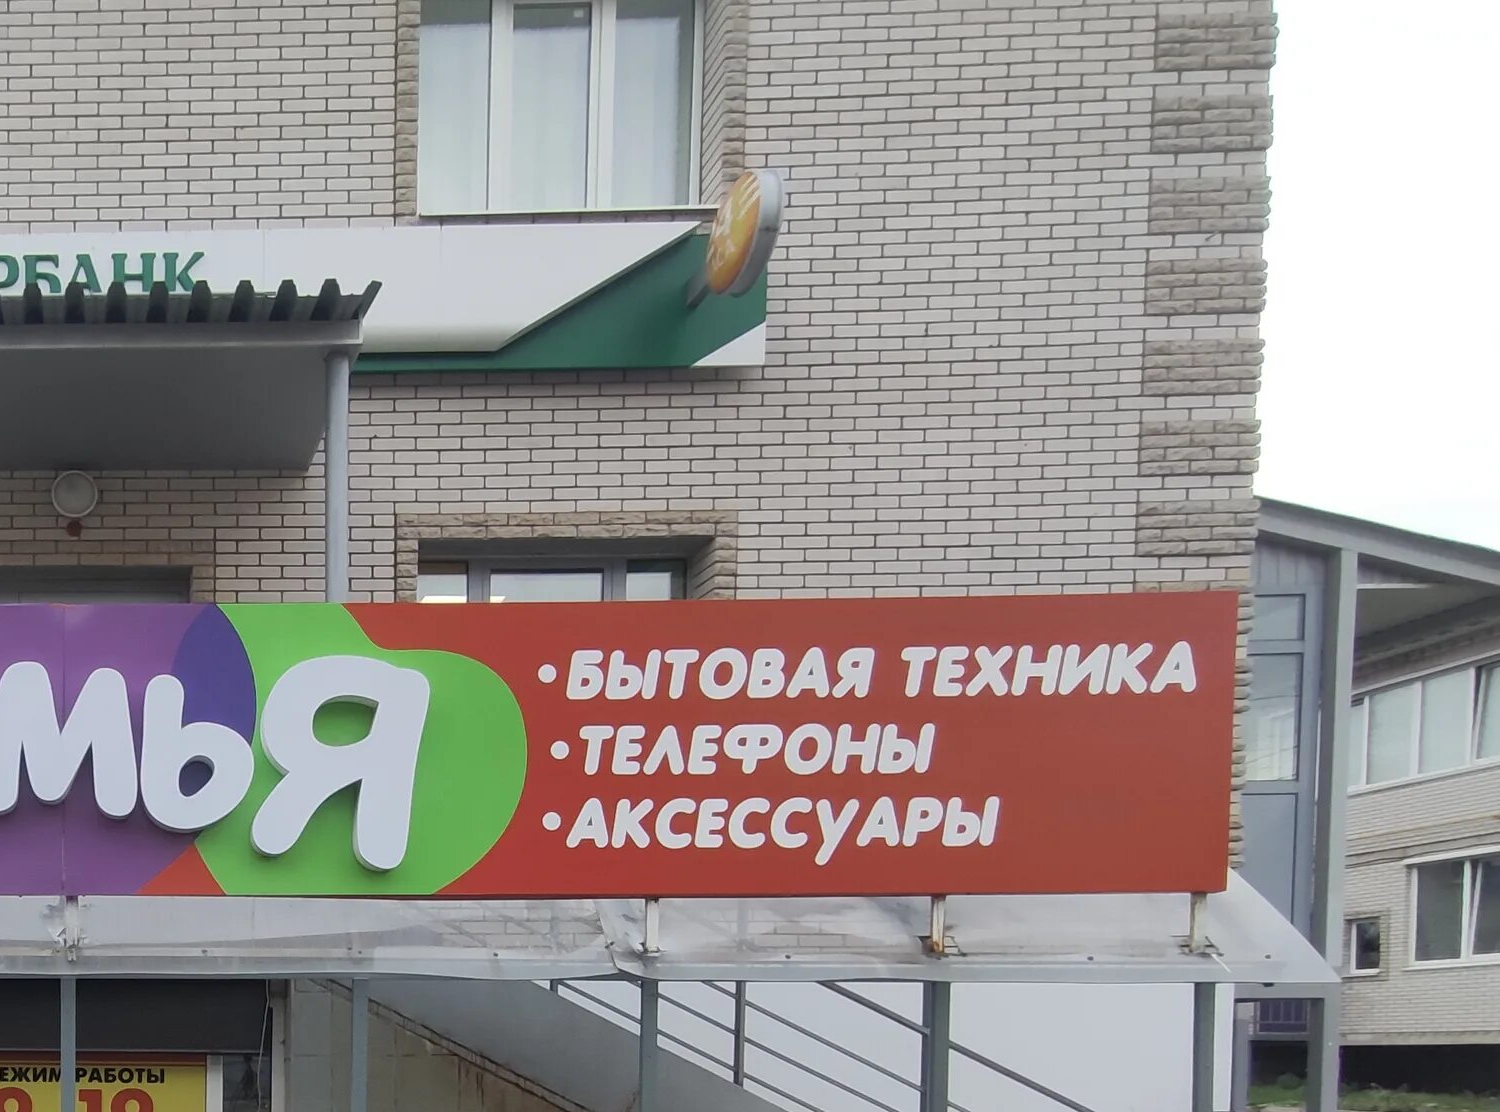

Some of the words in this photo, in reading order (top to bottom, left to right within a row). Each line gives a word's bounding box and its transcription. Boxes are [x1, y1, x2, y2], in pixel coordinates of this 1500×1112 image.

[566, 647, 876, 700] БЫТОВАЯ
[901, 641, 1197, 698] ТЕХНИКА
[579, 723, 937, 776] ТЕЛЕФОНЫ
[566, 796, 1001, 866] АКСЕССУАРЫ
[75, 1068, 165, 1084] РАБОТЫ
